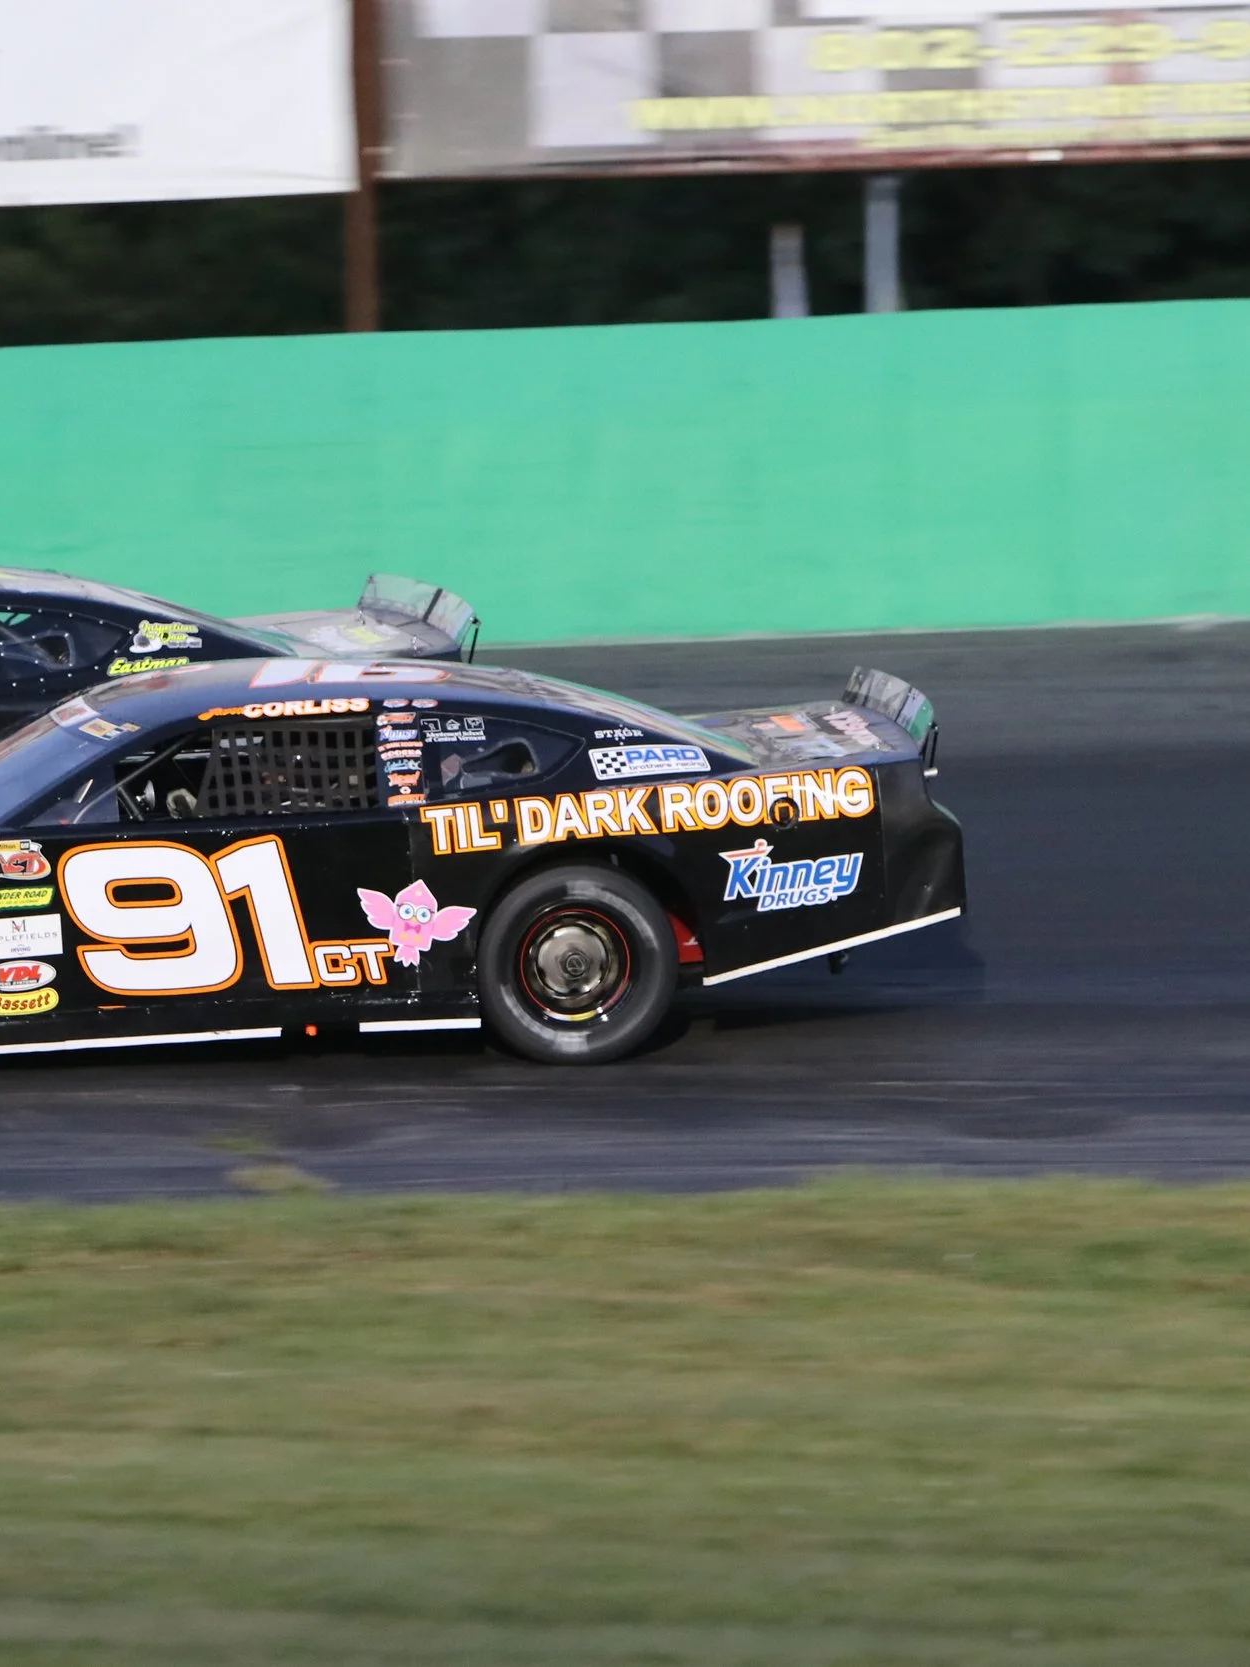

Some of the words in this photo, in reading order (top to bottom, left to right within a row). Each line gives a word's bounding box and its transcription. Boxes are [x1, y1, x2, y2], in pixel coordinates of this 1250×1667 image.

[107, 657, 189, 675] Eastman
[244, 698, 370, 718] CORLISS
[625, 749, 700, 764] PARD
[420, 800, 509, 855] TIL'
[514, 787, 659, 846] DARK
[658, 766, 875, 833] ROOFING
[724, 856, 863, 900] Kinney
[23, 889, 48, 898] ROAD
[750, 887, 820, 909] DRUGS
[57, 834, 320, 996] 91
[313, 939, 394, 986] CT
